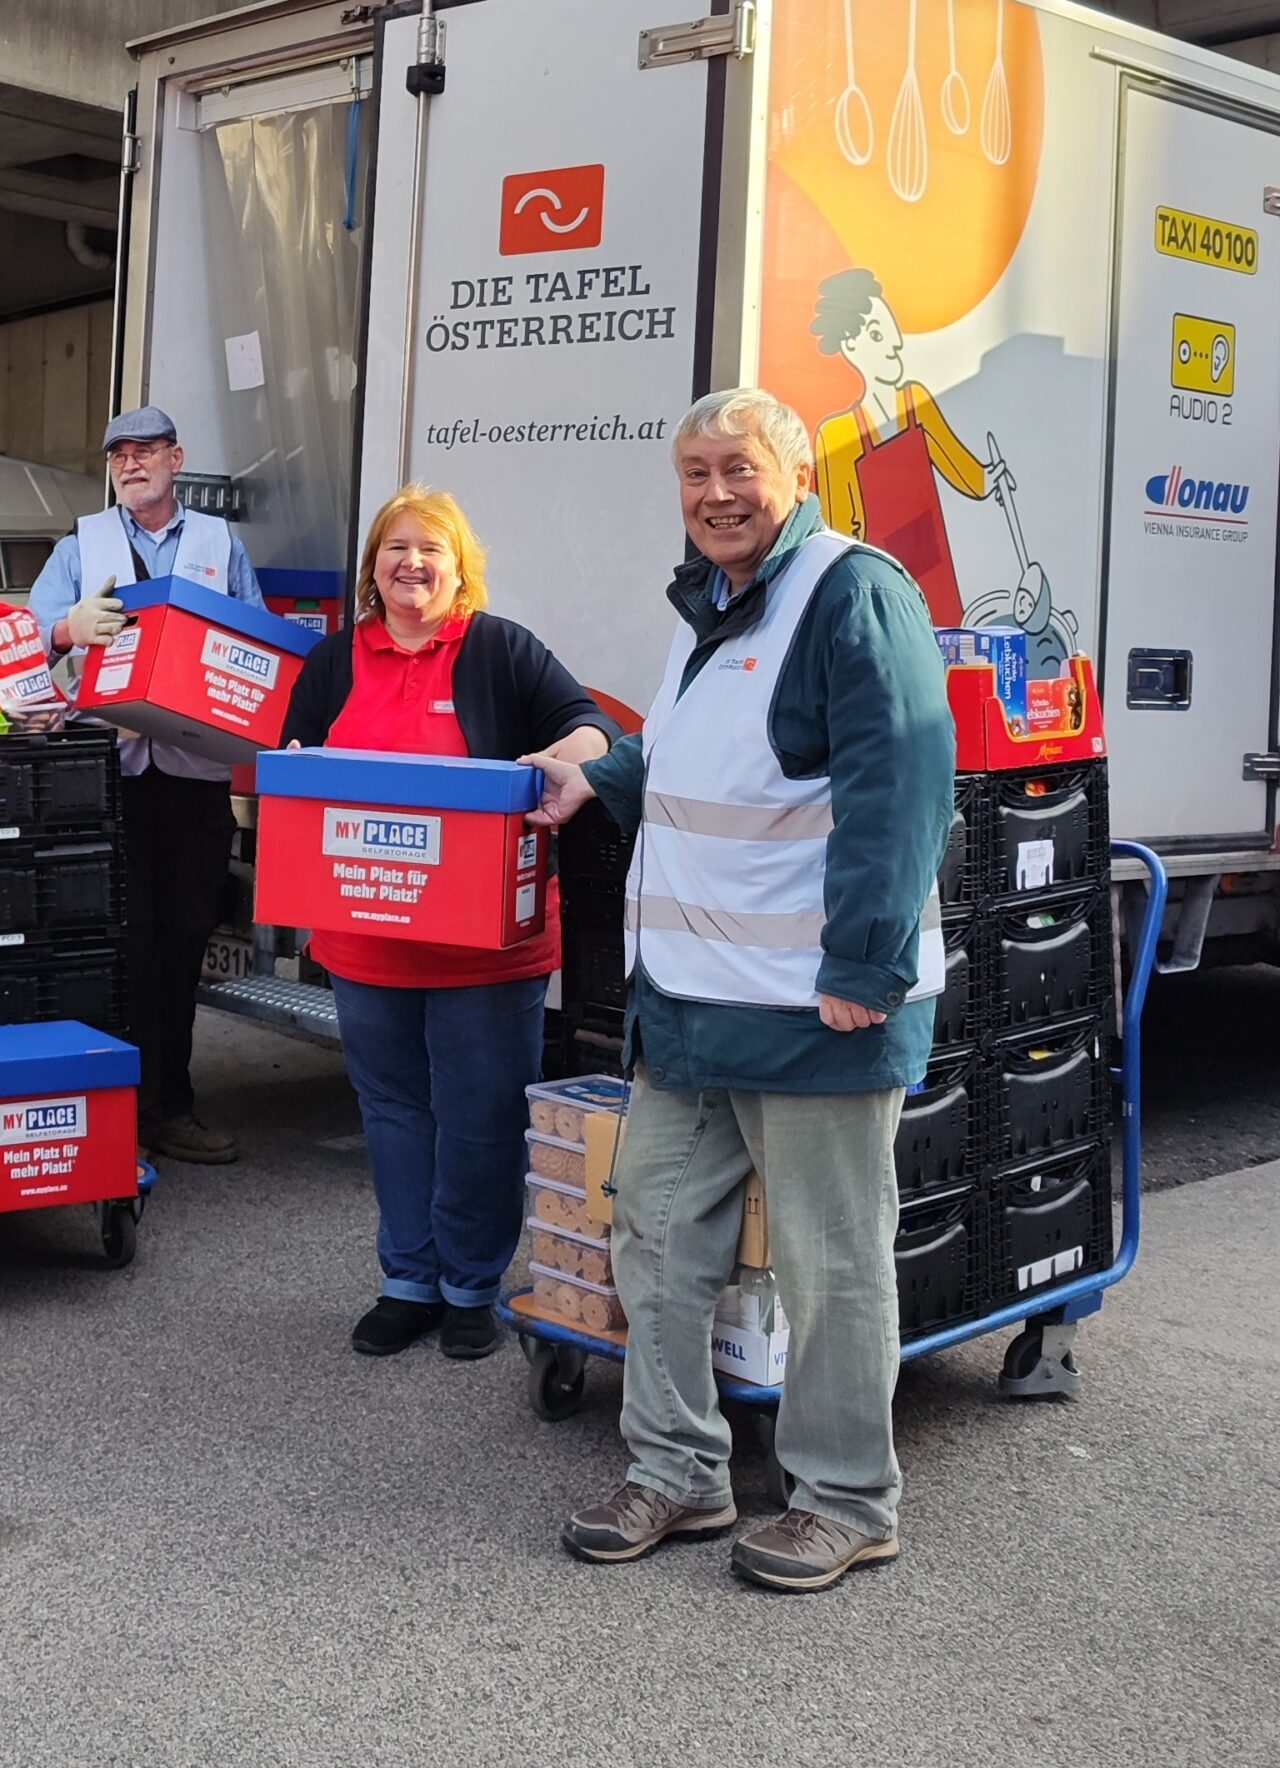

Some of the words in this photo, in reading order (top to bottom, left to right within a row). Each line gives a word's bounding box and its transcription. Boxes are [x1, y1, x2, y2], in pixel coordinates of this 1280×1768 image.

[1158, 213, 1197, 254] TAXI
[450, 276, 513, 310] DIE
[525, 265, 651, 303] TAFEL
[425, 306, 676, 353] ÖSTERREICH
[1170, 394, 1218, 424] AUDIO
[1222, 402, 1233, 425] 2
[426, 414, 667, 450] tafel-oesterreich.at
[1144, 521, 1174, 537] VIENNA
[1176, 525, 1221, 541] INSURANCE
[1222, 529, 1249, 543] GROUP
[211, 641, 229, 658] MY
[230, 647, 269, 675] PLACE
[19, 675, 50, 697] PLACE
[205, 670, 227, 689] Mein
[228, 679, 250, 697] Platz
[335, 820, 361, 840] MY
[363, 819, 428, 850] PLACE
[361, 846, 427, 859] SELFSTORAGE
[332, 862, 366, 881] Mein
[370, 865, 404, 884] Platz
[407, 869, 428, 887] für
[340, 883, 377, 900] mehr
[3, 1112, 23, 1130] MY
[26, 1105, 76, 1130] PLACE
[3, 1149, 30, 1165] Mein
[33, 1146, 60, 1161] Platz
[62, 1144, 78, 1159] für
[10, 1164, 39, 1180] mehr
